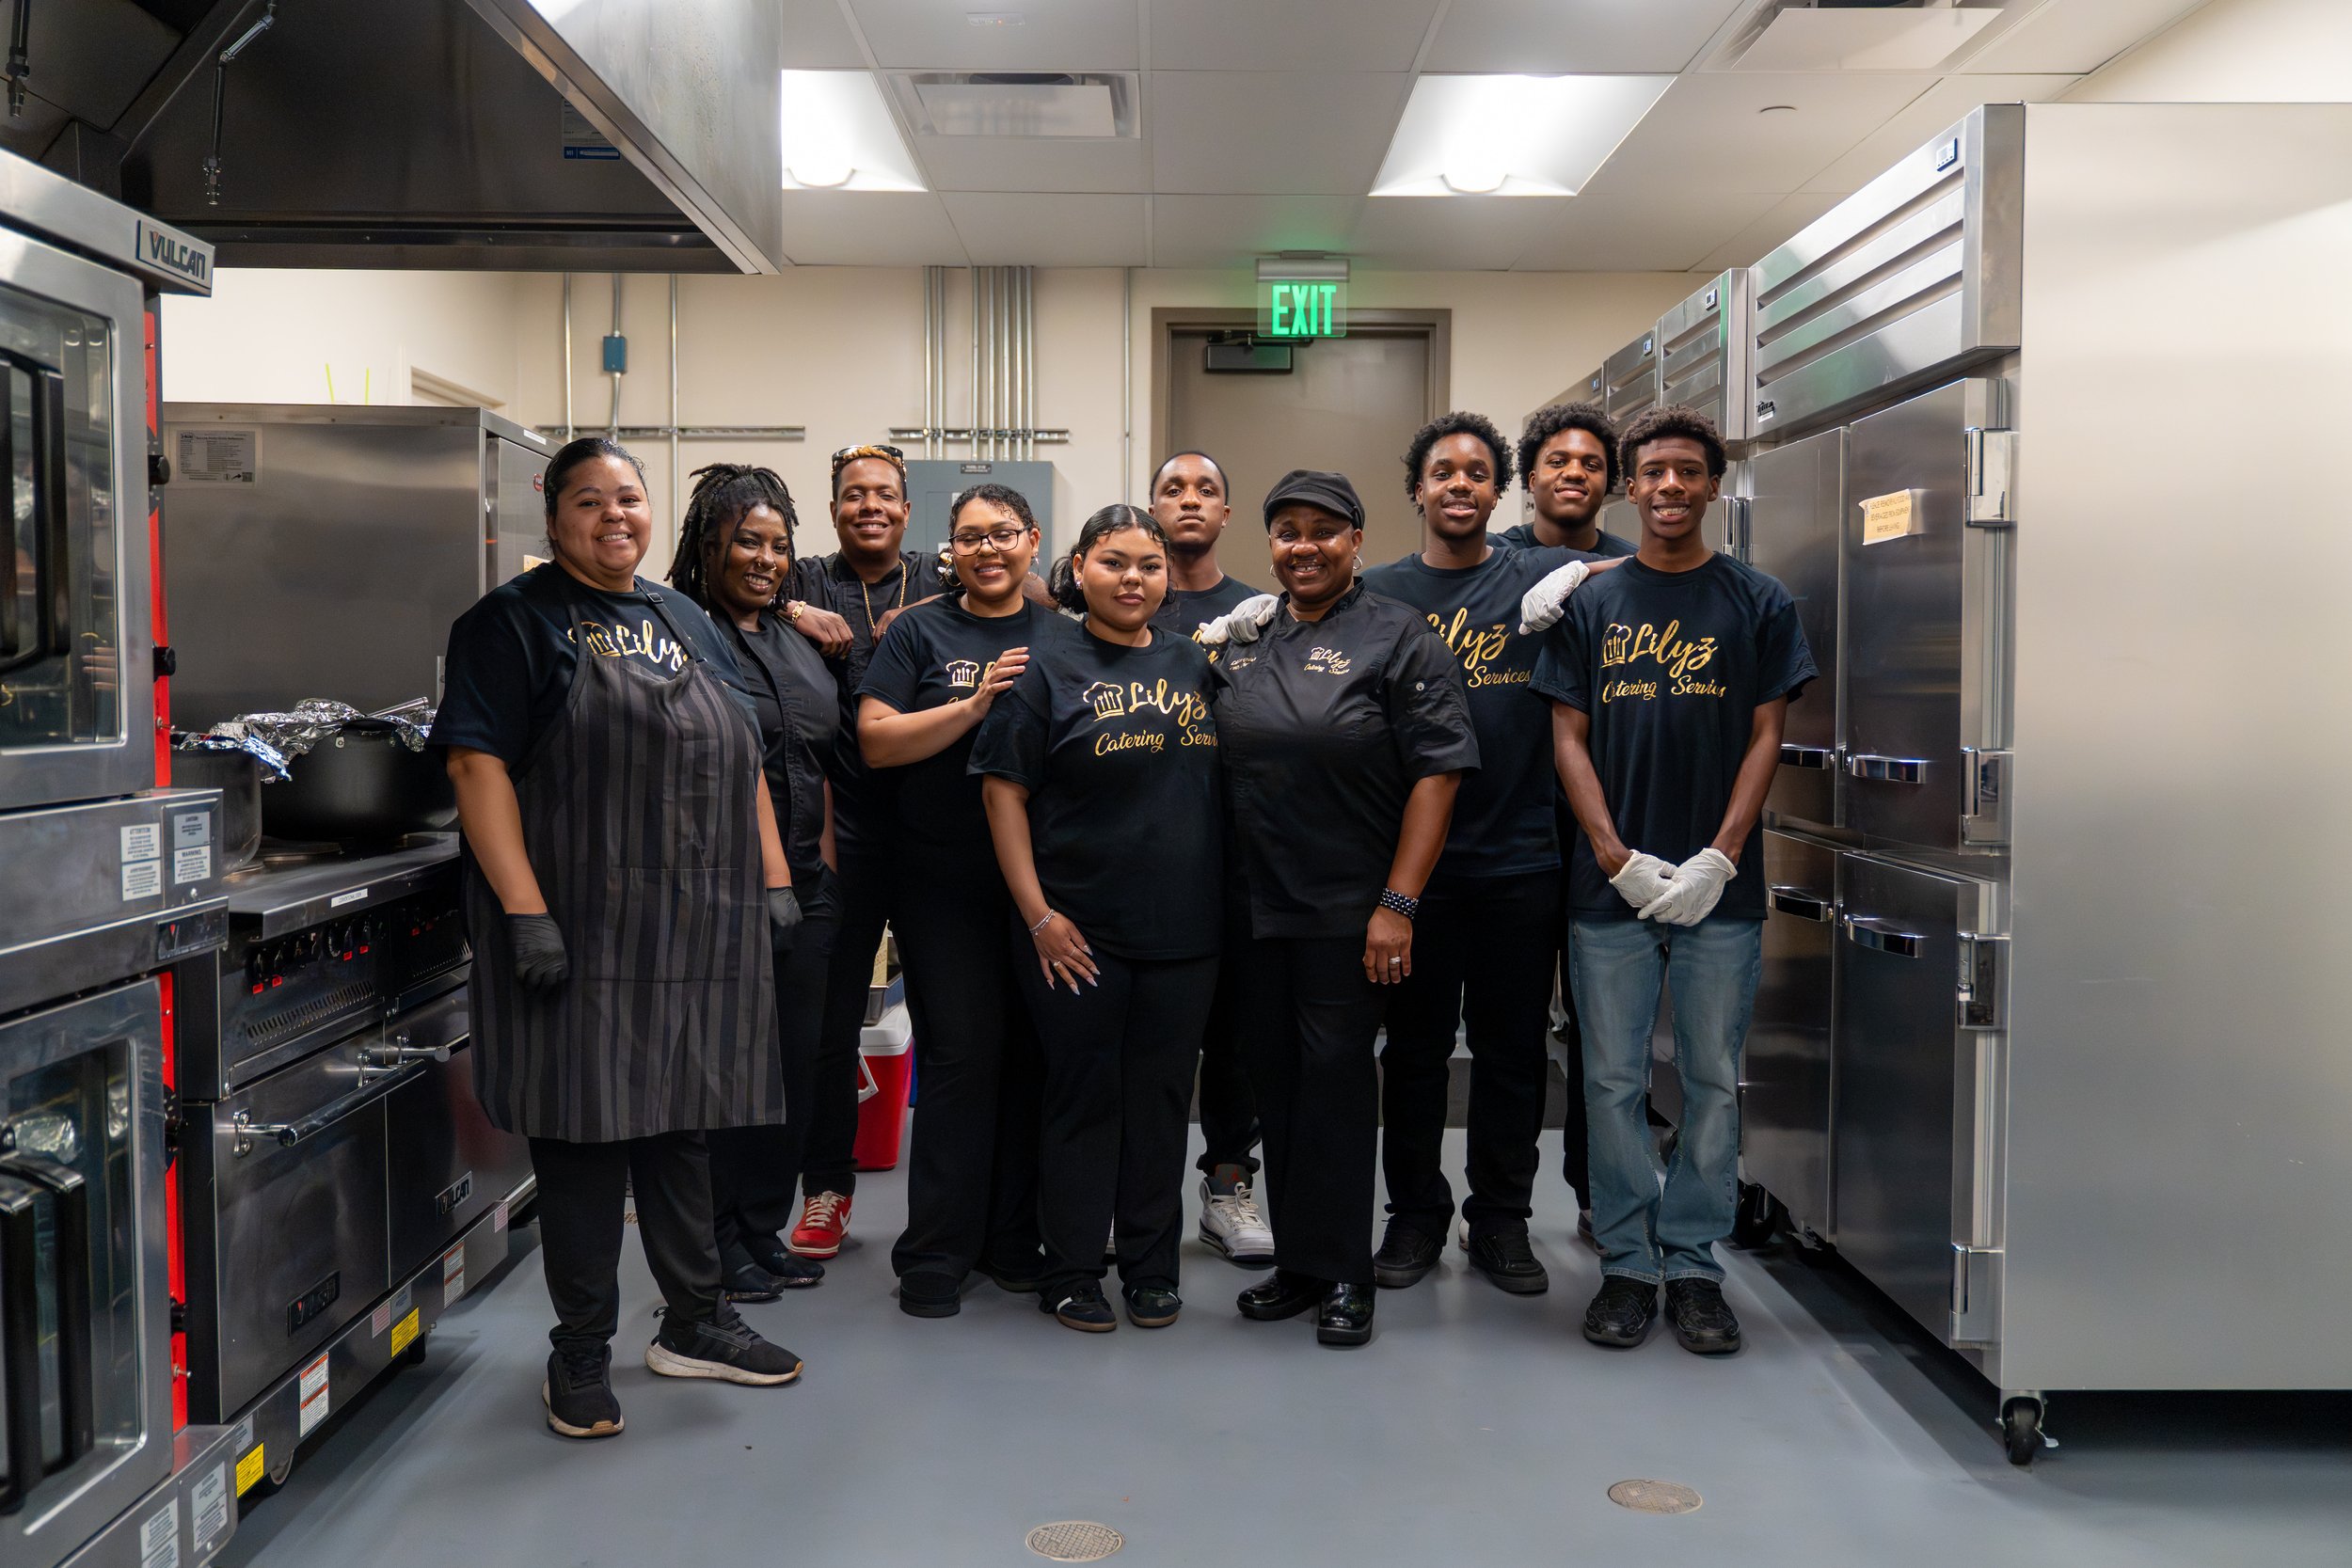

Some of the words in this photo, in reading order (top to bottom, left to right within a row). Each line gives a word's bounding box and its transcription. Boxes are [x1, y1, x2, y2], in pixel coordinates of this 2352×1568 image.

[150, 230, 206, 280] VULCAN
[1272, 285, 1337, 335] EXIT
[616, 619, 689, 672] Lily
[1318, 649, 1352, 669] Lilyz
[1628, 620, 1719, 678] Lilyz
[1468, 665, 1531, 688] Services
[1129, 678, 1207, 727] Lilyz
[1095, 730, 1165, 756] Catering
[1181, 724, 1218, 747] Servi
